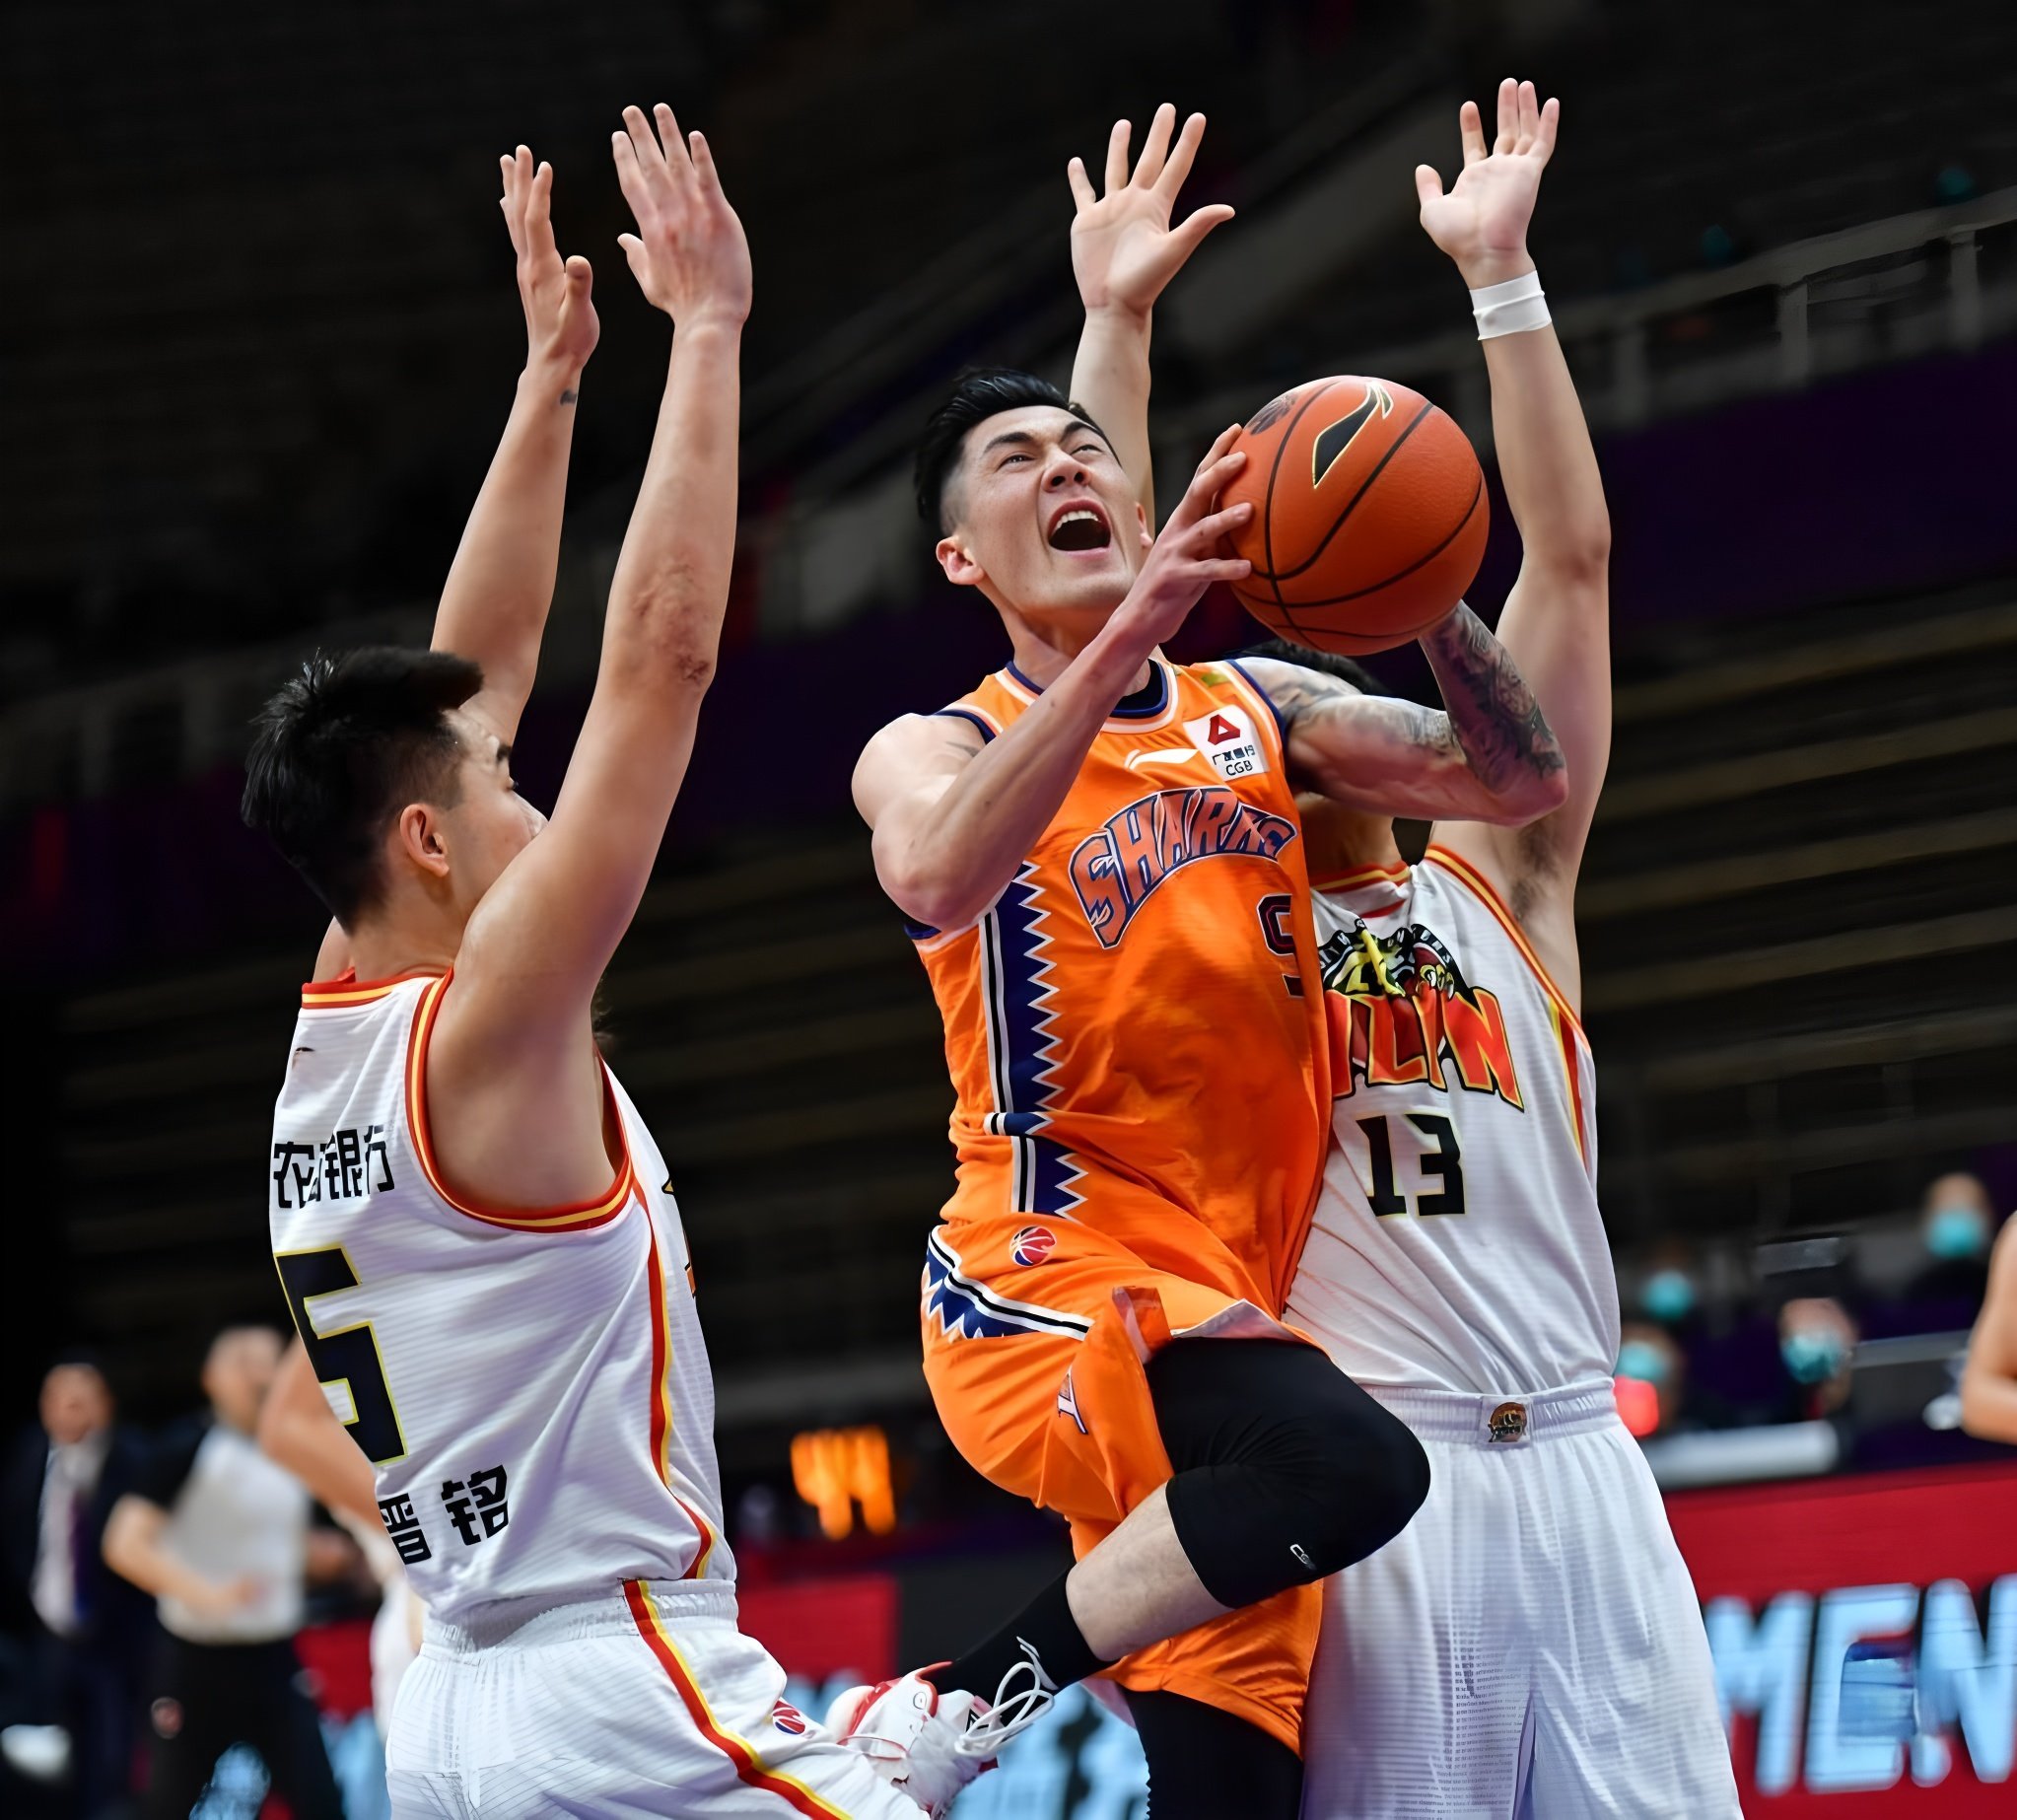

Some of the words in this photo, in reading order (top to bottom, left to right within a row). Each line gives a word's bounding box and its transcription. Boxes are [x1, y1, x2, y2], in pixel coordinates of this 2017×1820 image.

[1225, 759, 1253, 777] CGB
[272, 1125, 395, 1210] 农银行
[1355, 1111, 1467, 1218] 13
[272, 1241, 409, 1468] 5
